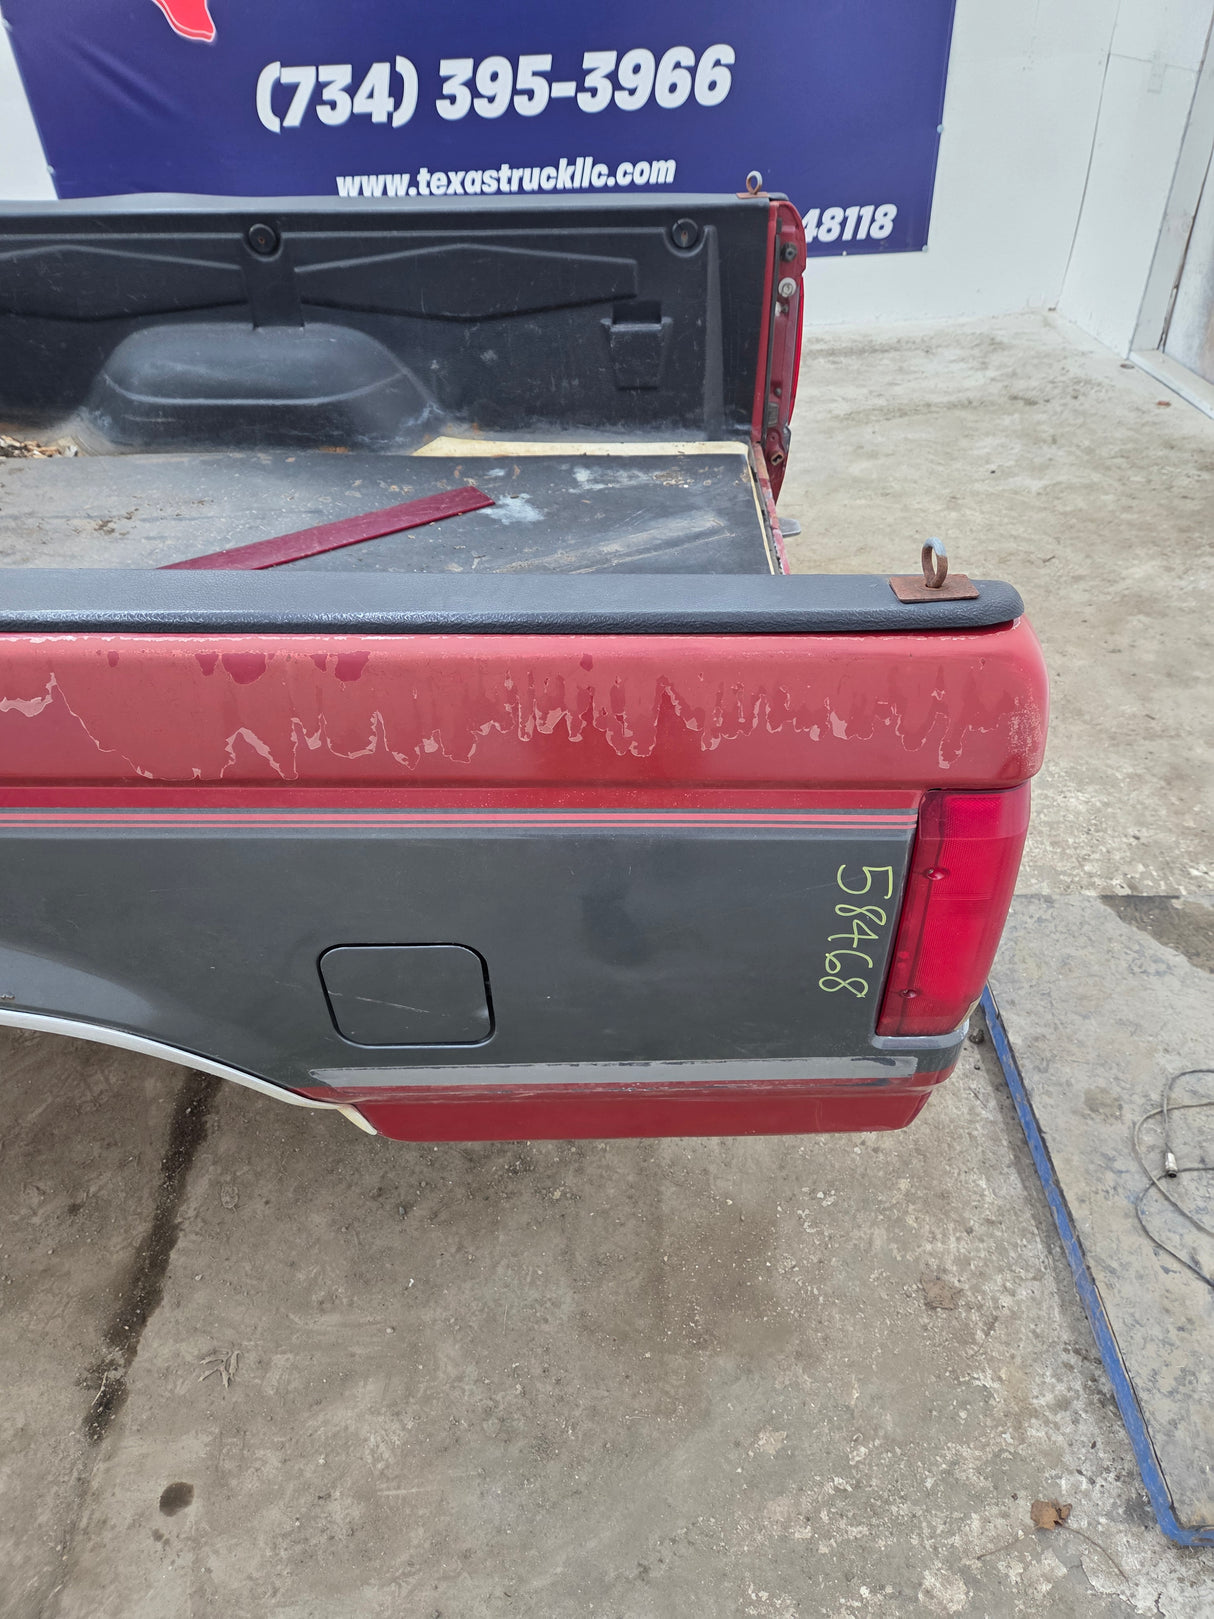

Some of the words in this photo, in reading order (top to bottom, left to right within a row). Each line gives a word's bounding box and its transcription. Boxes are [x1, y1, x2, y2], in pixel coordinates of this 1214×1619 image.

[256, 55, 418, 133] (734)
[437, 44, 735, 120] 395-3966
[336, 157, 677, 197] www.texastruckllc.com
[802, 203, 897, 243] 48118
[818, 864, 894, 998] 58468
